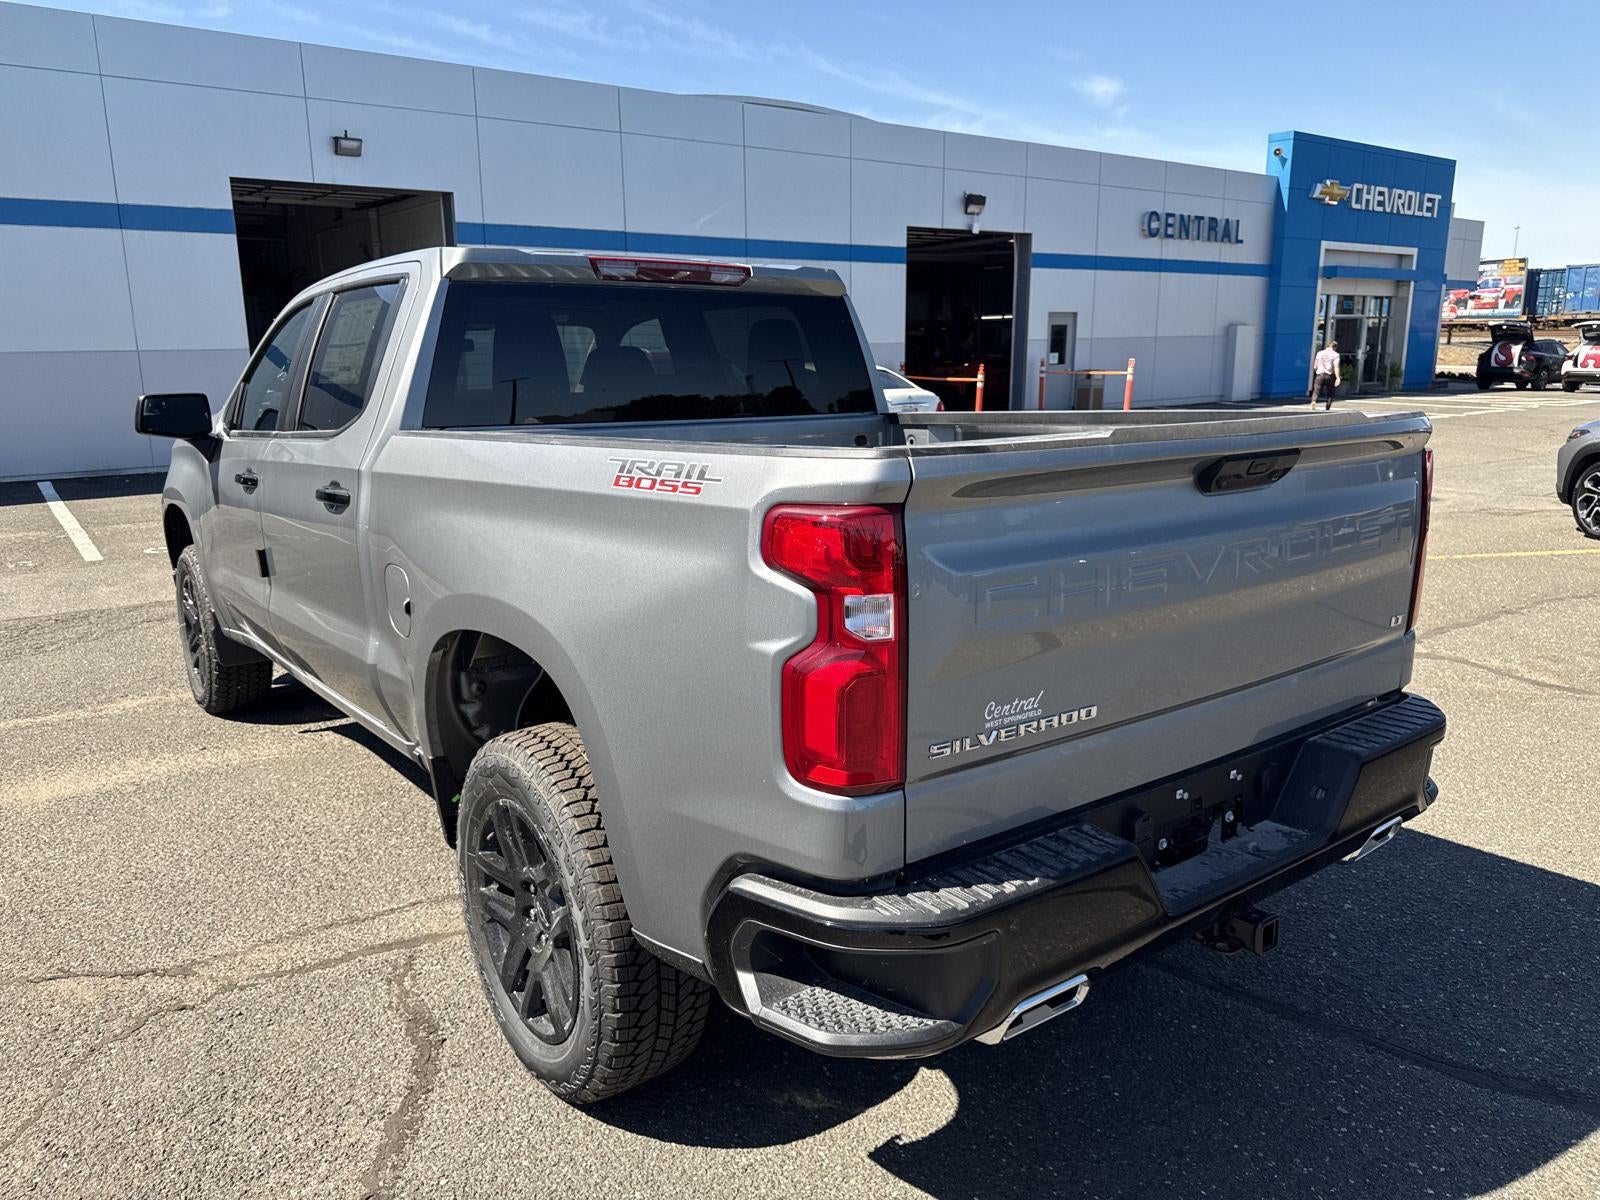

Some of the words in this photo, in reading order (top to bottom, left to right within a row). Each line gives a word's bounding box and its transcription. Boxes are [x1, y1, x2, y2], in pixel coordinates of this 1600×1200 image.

[1351, 183, 1441, 218] CHEVROLET
[1145, 210, 1244, 244] CENTRAL
[609, 458, 722, 483] TRAIL
[613, 475, 703, 496] BOSS
[974, 504, 1412, 628] CHEVROLET
[984, 689, 1044, 720] Central
[984, 718, 1003, 729] WEST
[1003, 709, 1042, 726] SPRINGFIELD
[928, 705, 1098, 759] SILVERADO
